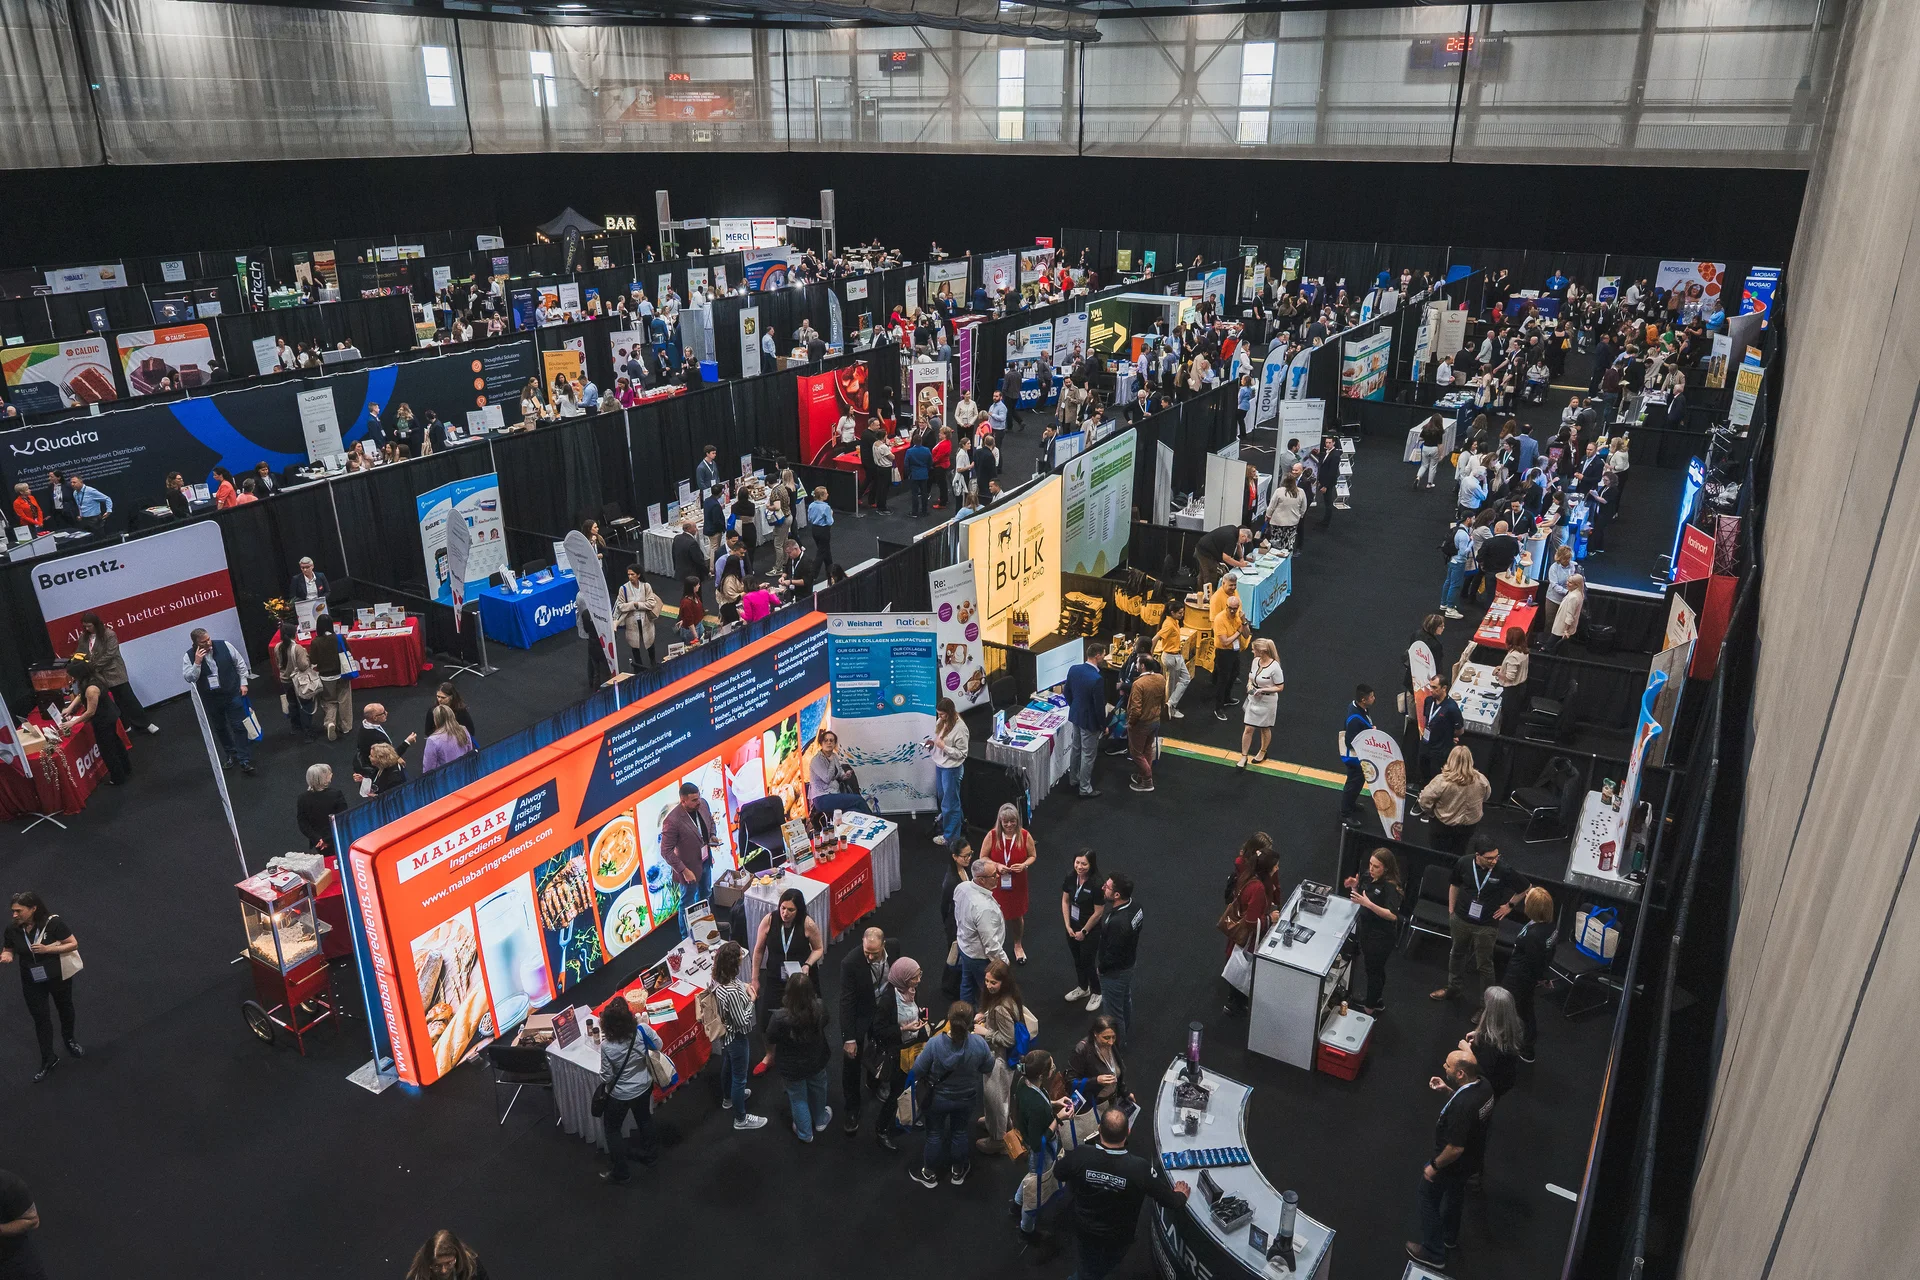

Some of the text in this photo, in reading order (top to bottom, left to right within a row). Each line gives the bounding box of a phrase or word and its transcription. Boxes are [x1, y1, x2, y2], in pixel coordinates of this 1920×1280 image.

[605, 216, 637, 231] BAR
[725, 233, 750, 241] MERCI
[74, 345, 100, 356] CALDIC
[1020, 386, 1058, 400] ECOAB
[1262, 386, 1272, 412] IMCD
[1289, 387, 1298, 400] IM
[34, 430, 98, 452] Quadra
[24, 465, 42, 474] Fresh
[42, 460, 72, 471] Approach
[81, 452, 112, 464] Ingredient
[112, 445, 146, 457] Distribution
[38, 558, 125, 590] Barentz.
[997, 536, 1044, 590] BULK
[1023, 575, 1030, 586] BY
[67, 587, 223, 644] Als a better solution.
[551, 600, 578, 618] hygie
[896, 618, 929, 626] naticol
[794, 637, 810, 650] Sourced
[351, 656, 389, 672] ntz.
[778, 658, 790, 668] North
[790, 650, 807, 662] American
[778, 650, 819, 675] Warehousing Services
[712, 668, 752, 692] Custom Pack Sizes
[713, 676, 756, 702] Systematic Batching
[788, 670, 806, 684] Certified
[714, 700, 726, 712] Small
[727, 695, 738, 707] Units
[744, 685, 756, 698] Large
[757, 678, 774, 690] Formats
[755, 699, 768, 709] Vegan
[612, 691, 705, 743] Private Label and Custom Dry Blending
[714, 710, 731, 723] Kosher,
[745, 695, 759, 707] Gluten
[613, 738, 638, 754] Premixes
[614, 730, 672, 765] Contract Manufacturing
[615, 769, 623, 778] On
[624, 762, 634, 772] Site
[635, 751, 654, 766] Product
[655, 736, 686, 755] Development
[76, 743, 100, 779] Bare
[616, 756, 661, 785] Innovation Center
[519, 789, 547, 808] Always
[514, 811, 542, 832] the bar
[516, 801, 542, 821] raising
[412, 811, 508, 870] MALABAR
[449, 834, 502, 869] Ingredients
[422, 826, 554, 908] www.malabaringredients.com
[354, 858, 408, 1074] www.malabaringredients.com
